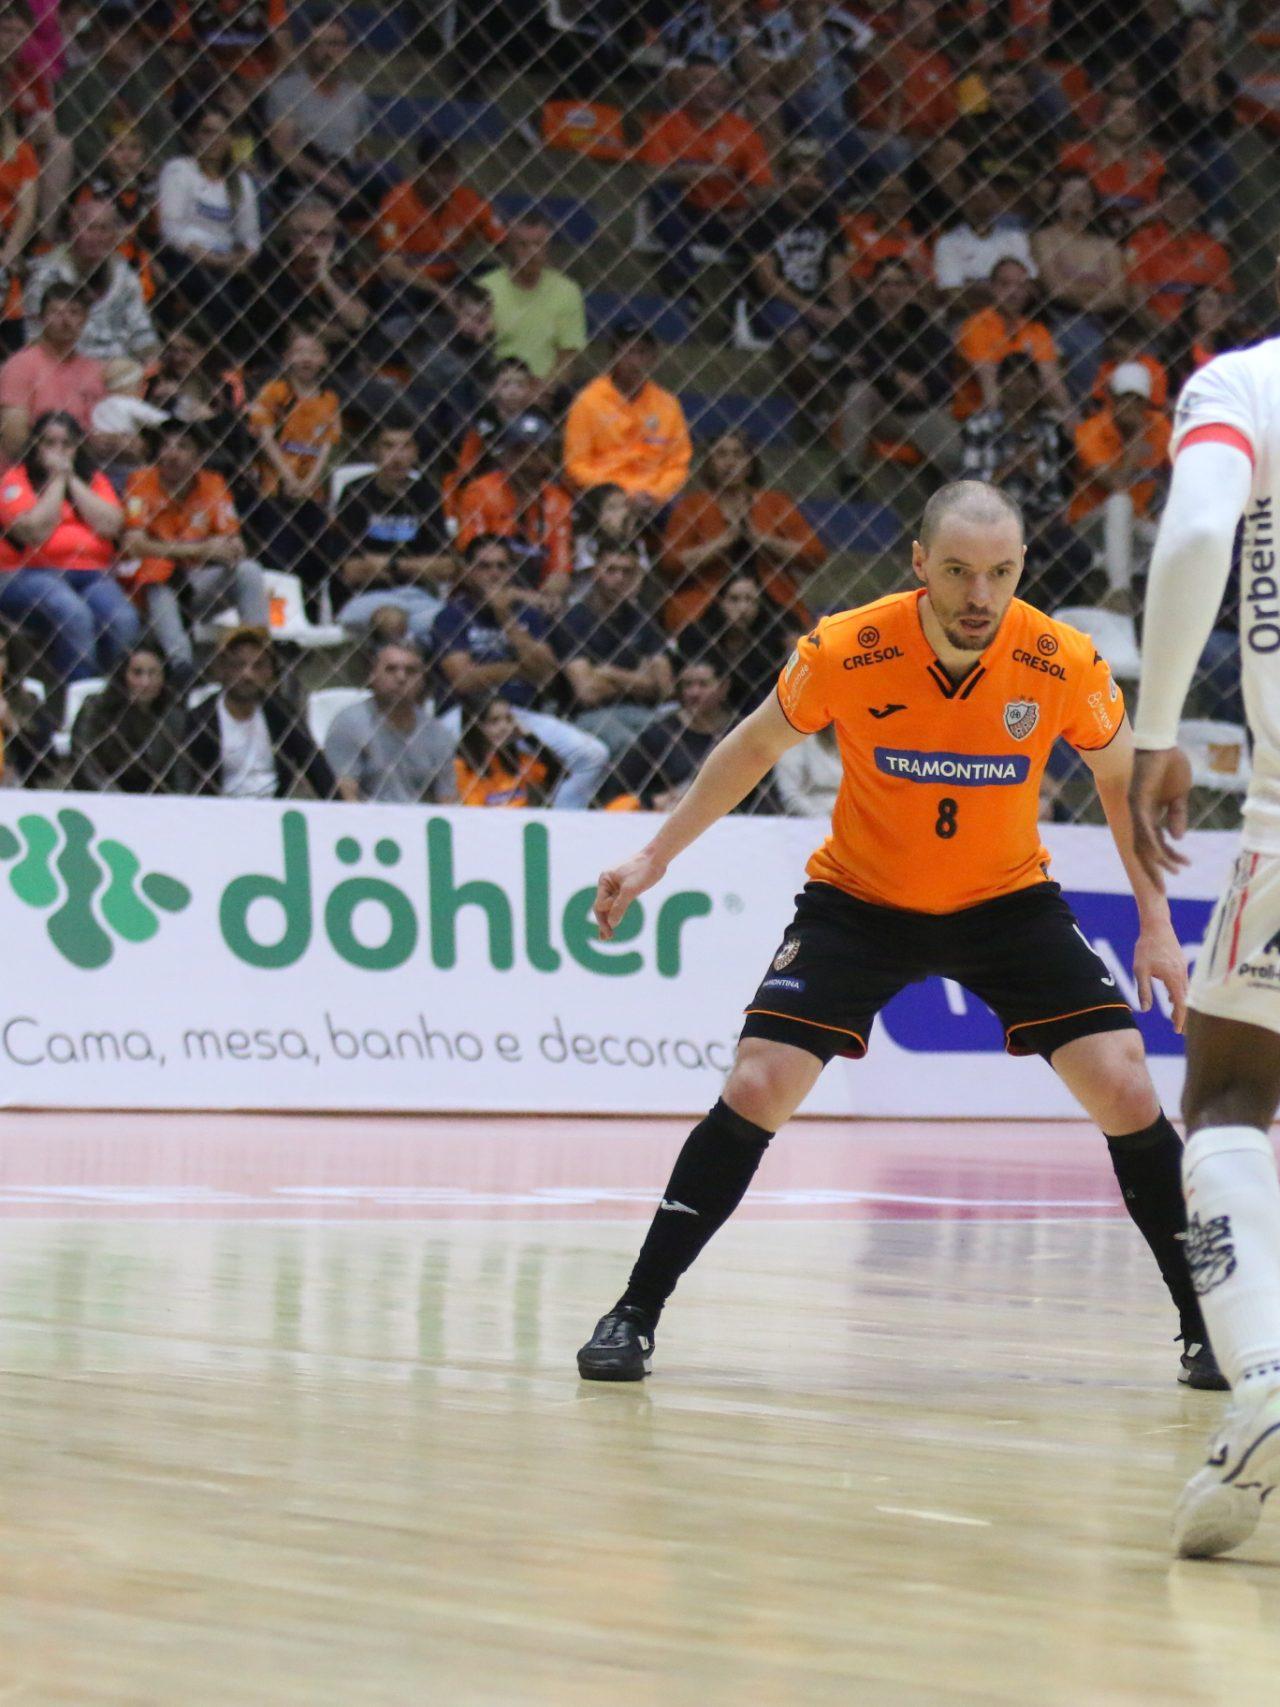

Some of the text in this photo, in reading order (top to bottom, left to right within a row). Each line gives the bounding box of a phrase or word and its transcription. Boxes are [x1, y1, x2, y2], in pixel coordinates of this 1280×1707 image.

[843, 645, 904, 671] CRESOL
[1012, 649, 1066, 681] CRESOL
[886, 756, 1016, 779] TRAMONTINA
[935, 798, 957, 839] 8
[219, 809, 712, 978] döhler
[3, 1011, 740, 1074] Cama, mesa, banho e decoraç
